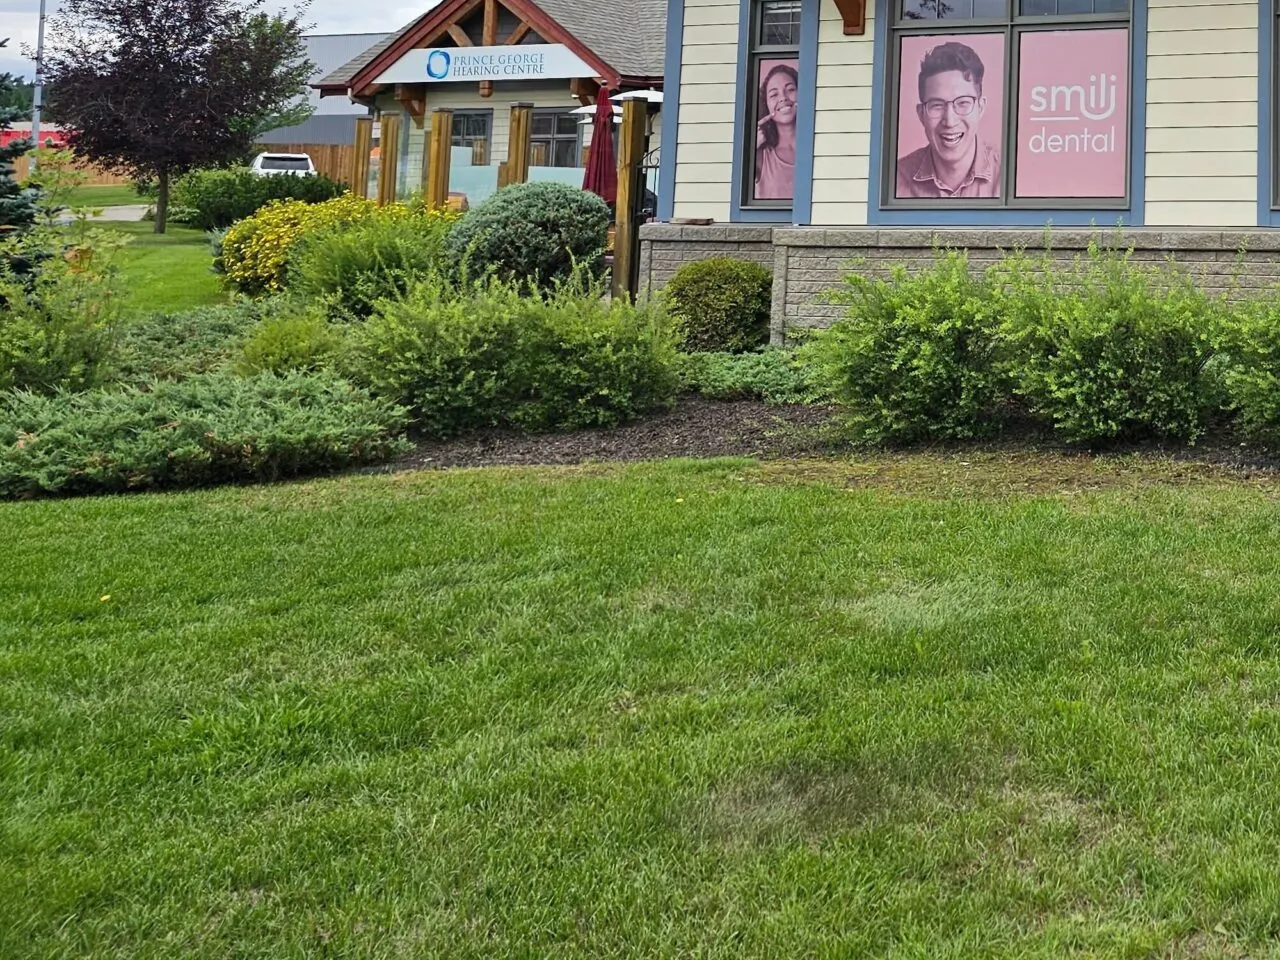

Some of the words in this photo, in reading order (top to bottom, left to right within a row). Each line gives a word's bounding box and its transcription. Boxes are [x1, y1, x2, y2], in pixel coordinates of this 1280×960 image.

[453, 54, 496, 66] PRINCE
[498, 53, 545, 65] GEORGE
[453, 65, 500, 77] HEARING
[503, 63, 545, 75] CENTRE
[1028, 125, 1115, 153] dental
